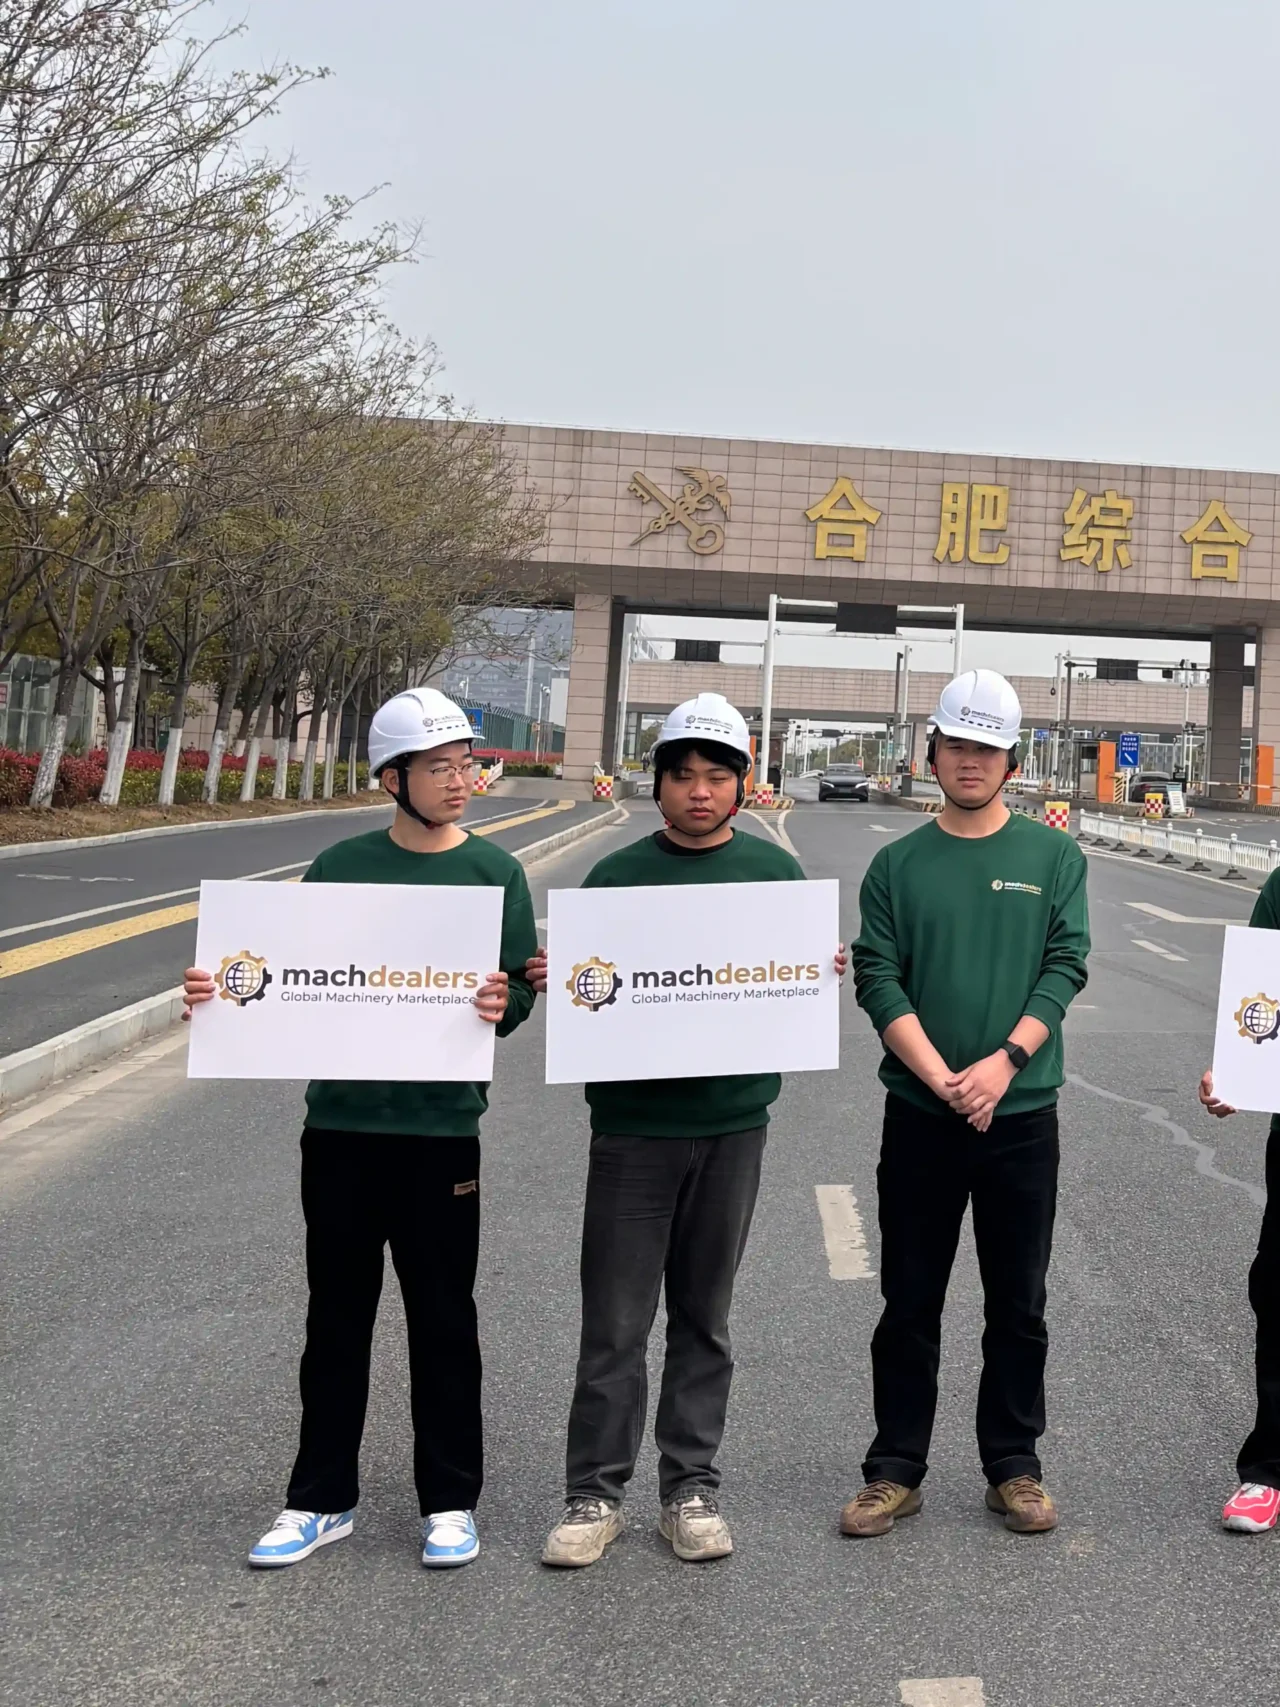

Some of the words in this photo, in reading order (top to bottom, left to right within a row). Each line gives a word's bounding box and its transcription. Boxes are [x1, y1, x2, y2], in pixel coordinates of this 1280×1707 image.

[282, 964, 479, 989] machdealers
[632, 960, 820, 989] machdealers
[281, 991, 322, 1003] Global
[326, 991, 394, 1006] Machinery
[632, 992, 672, 1005] Global
[675, 989, 741, 1003] Machinery
[744, 986, 820, 1000] Marketplace
